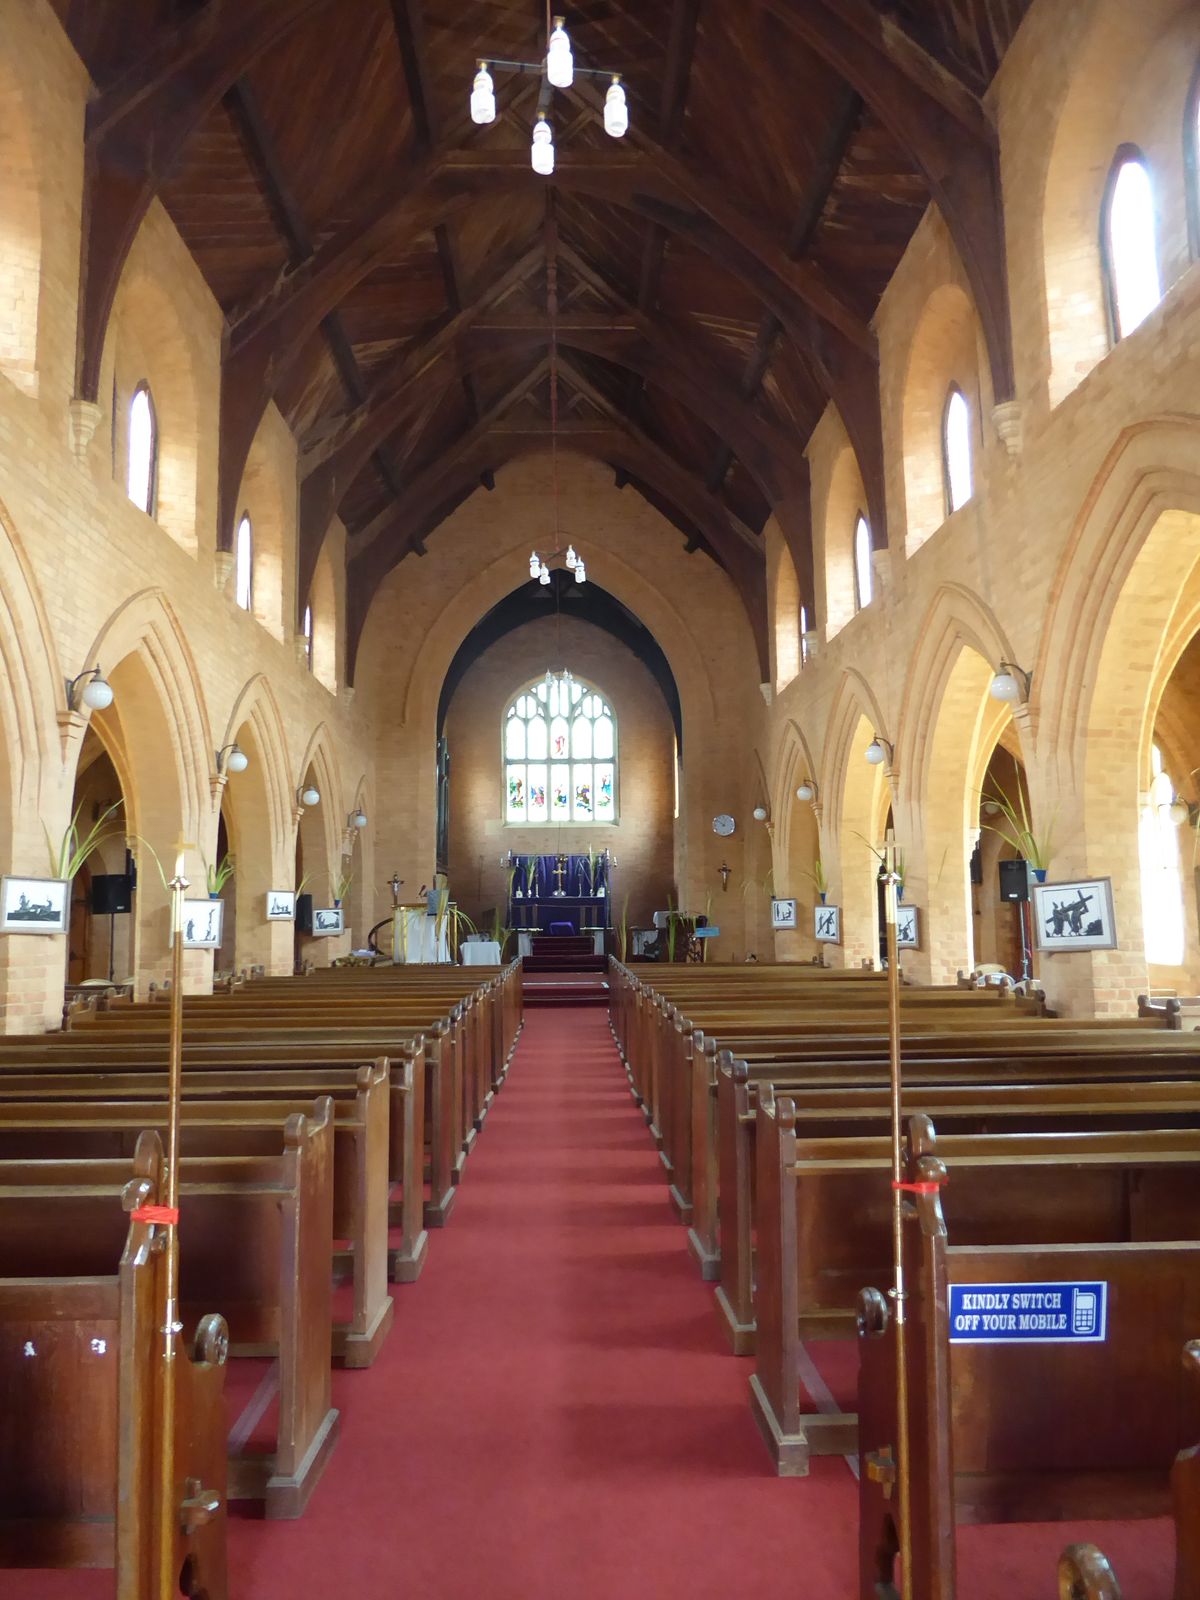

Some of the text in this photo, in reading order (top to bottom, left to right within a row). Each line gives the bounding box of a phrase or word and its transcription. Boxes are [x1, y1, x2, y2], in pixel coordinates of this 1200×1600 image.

[962, 1293, 1061, 1310] KINDLY SWITCH
[955, 1314, 1067, 1331] OFF YOUR MOBILE
